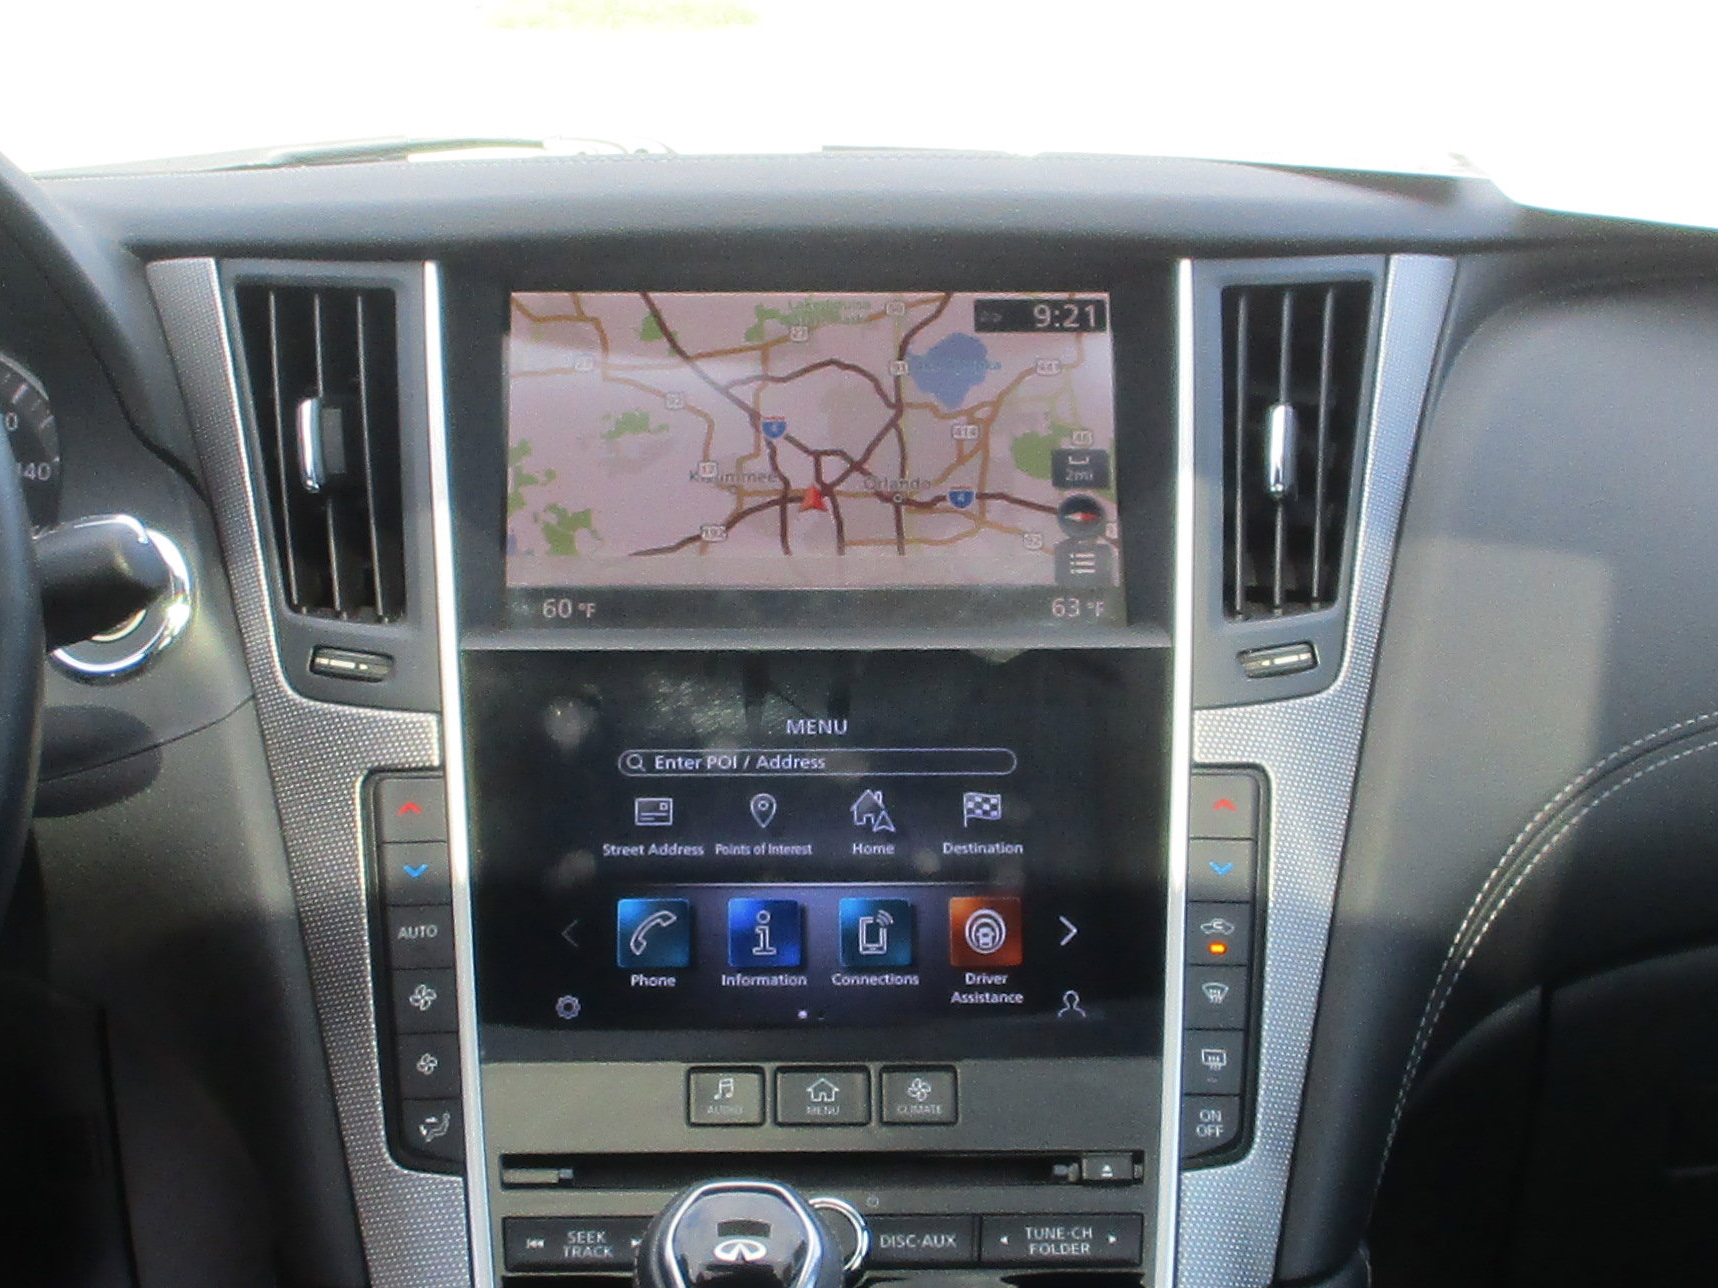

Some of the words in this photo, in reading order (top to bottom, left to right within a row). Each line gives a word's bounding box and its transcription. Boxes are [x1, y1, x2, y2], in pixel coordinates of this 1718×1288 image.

[1033, 304, 1097, 328] 9:21
[863, 476, 932, 490] Orlando
[541, 597, 574, 619] 60
[1050, 597, 1080, 618] 63
[786, 719, 848, 735] MENU
[654, 754, 703, 770] Enter
[707, 755, 737, 770] POI
[756, 754, 826, 770] Address
[602, 843, 644, 856] Street
[648, 843, 705, 856] Address
[715, 842, 750, 856] Points
[753, 842, 765, 855] of
[768, 842, 813, 855] Interest
[852, 842, 895, 855] Home
[943, 842, 1024, 854] Destination
[397, 924, 439, 939] AUTO
[630, 973, 677, 987] Phone
[721, 973, 808, 987] Information
[832, 972, 920, 986] Connections
[965, 972, 1008, 986] Driver
[951, 991, 1025, 1004] Assistance
[1198, 1110, 1222, 1123] ON
[1196, 1123, 1225, 1138] OFF
[567, 1230, 607, 1245] SEEK
[562, 1244, 614, 1259] TRACK
[1029, 1242, 1092, 1256] FOLDER
